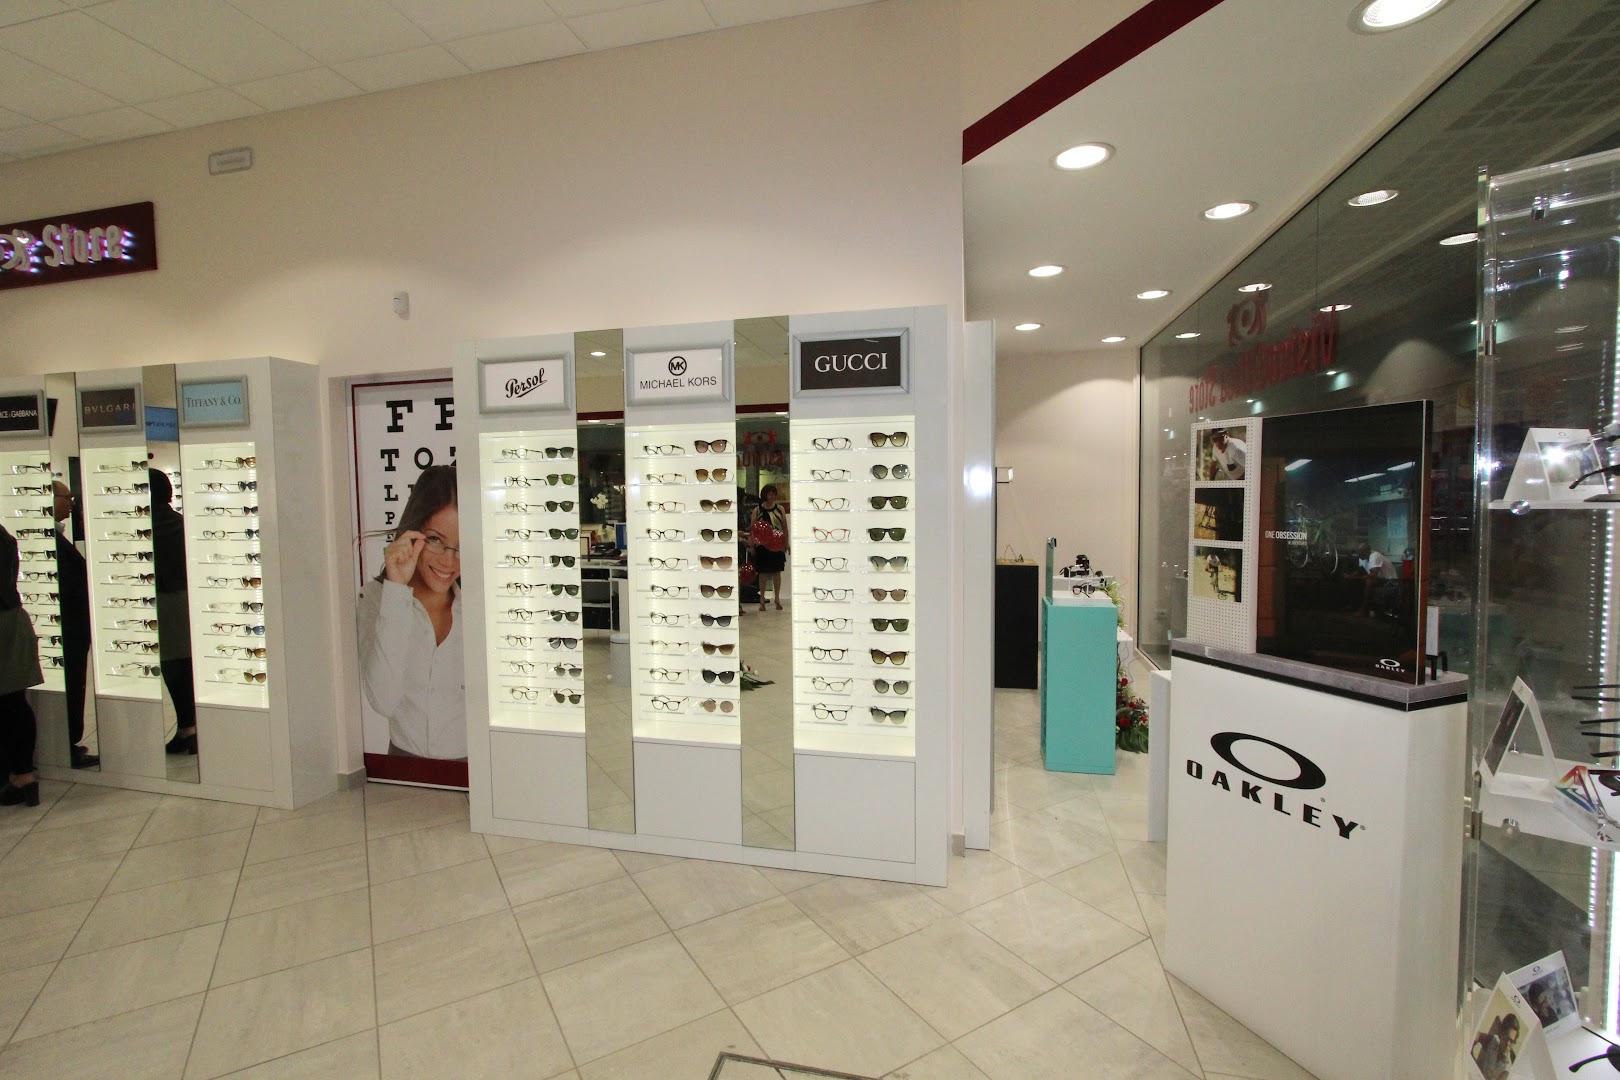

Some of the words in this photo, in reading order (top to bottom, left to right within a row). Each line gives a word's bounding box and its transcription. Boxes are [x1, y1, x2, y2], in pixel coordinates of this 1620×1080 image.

[42, 223, 122, 267] Store
[815, 352, 887, 373] GUCCI
[505, 367, 548, 398] Persol
[640, 378, 685, 390] MICHAEL
[687, 376, 717, 387] KORS
[220, 396, 227, 406] &
[11, 410, 38, 418] GABBANA
[84, 403, 136, 415] BVLGARI
[1264, 530, 1275, 539] ONE
[1275, 531, 1308, 541] OBSESSION
[1375, 663, 1406, 673] OAKLEY
[1186, 759, 1359, 840] OAKLEY
